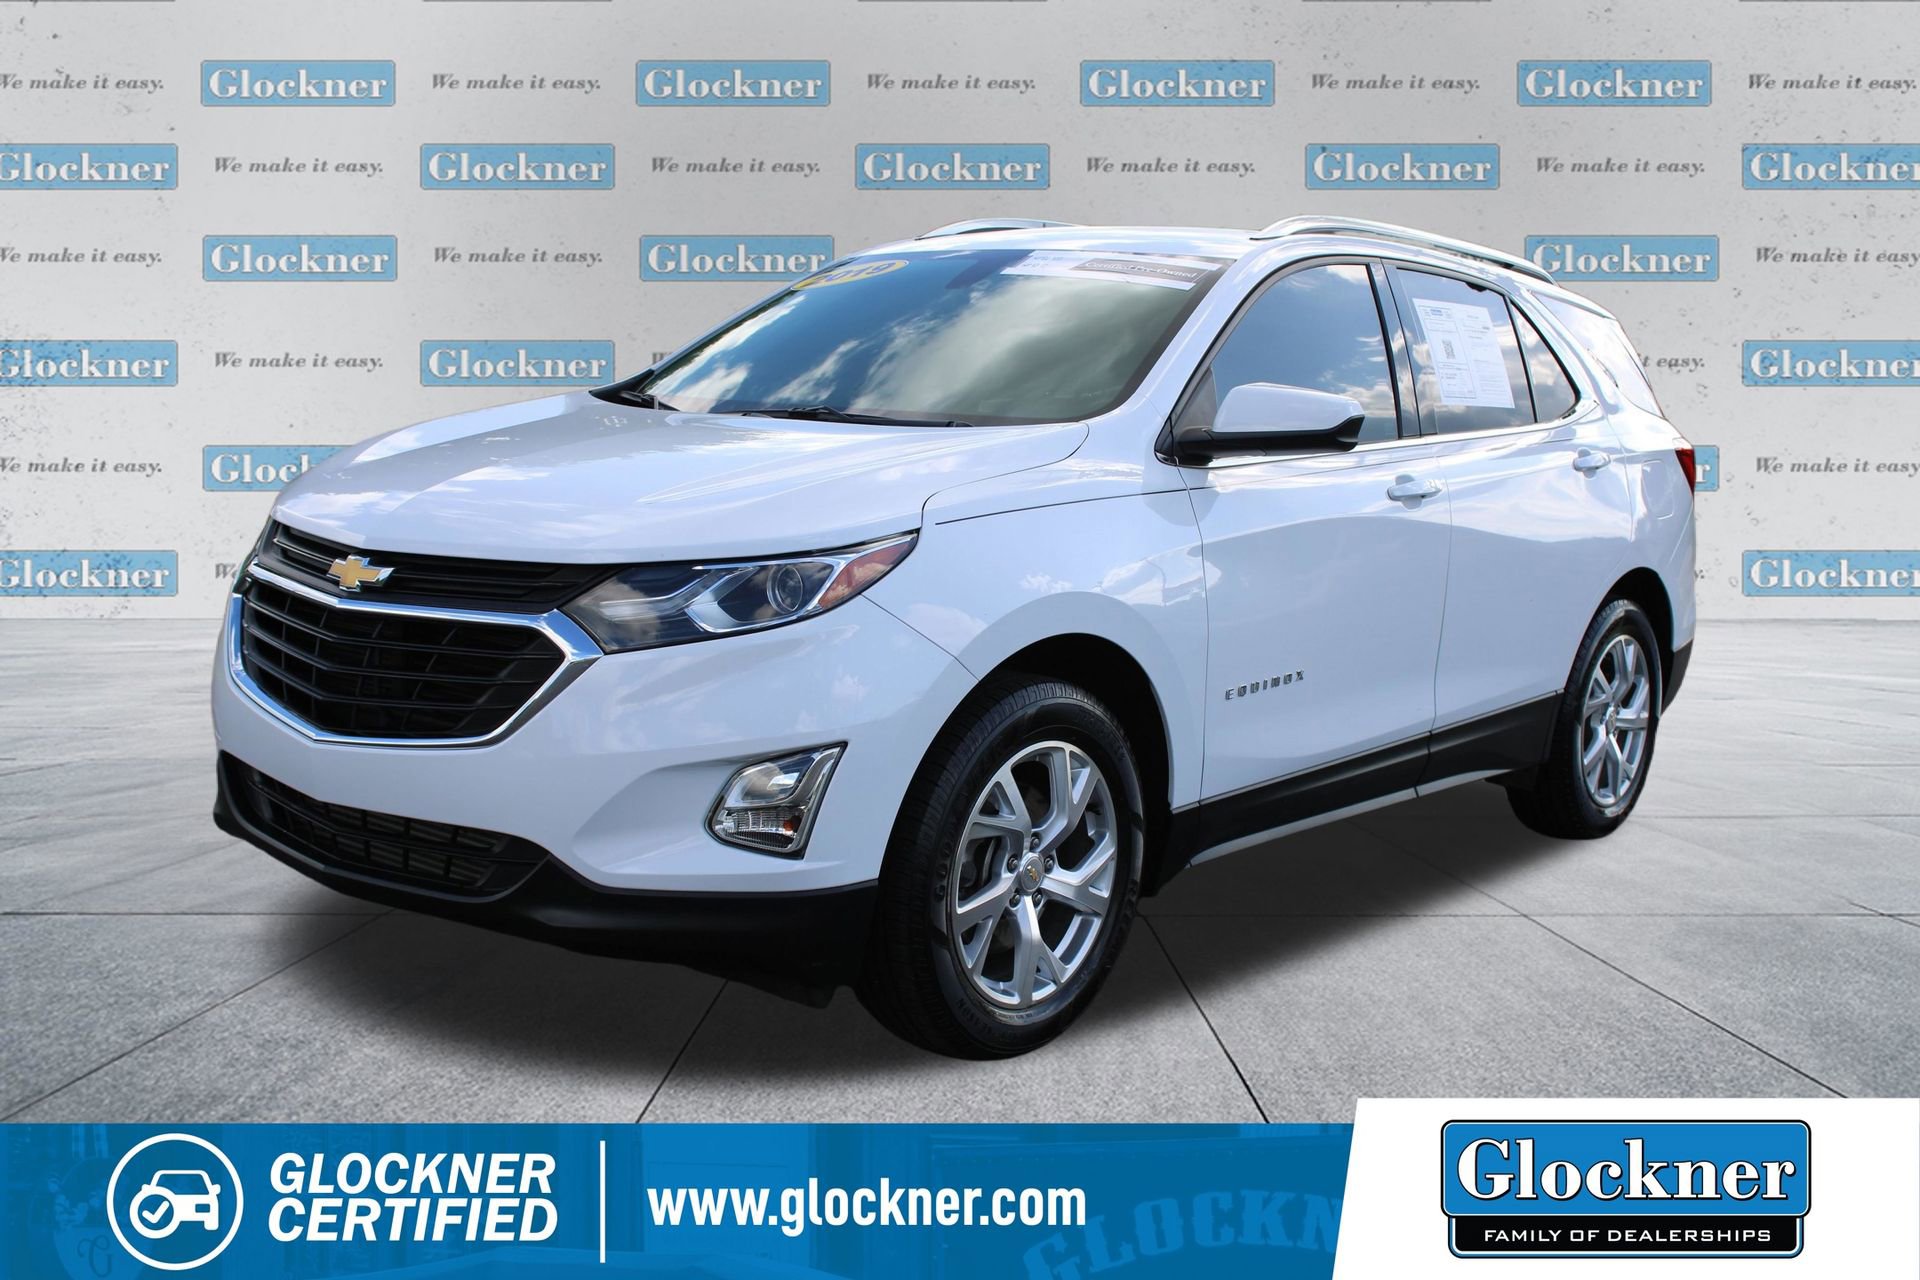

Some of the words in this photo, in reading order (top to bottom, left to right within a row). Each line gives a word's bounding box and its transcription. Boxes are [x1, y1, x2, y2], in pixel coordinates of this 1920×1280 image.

[30, 73, 88, 90] make
[94, 74, 110, 90] it
[116, 79, 165, 95] easy.
[209, 69, 388, 99] Glockner
[431, 73, 460, 90] We
[466, 73, 524, 90] make
[530, 74, 546, 90] it
[552, 79, 601, 95] easy.
[644, 69, 823, 99] Glockner
[866, 73, 895, 90] We
[901, 73, 959, 90] make
[965, 74, 981, 90] it
[987, 79, 1036, 95] easy.
[1088, 69, 1267, 99] Glockner
[1311, 73, 1340, 90] We
[1346, 73, 1404, 90] make
[1410, 74, 1426, 90] it
[1432, 79, 1481, 95] easy.
[1525, 69, 1704, 99] Glockner
[1748, 73, 1777, 90] We
[1783, 73, 1841, 90] make
[1847, 74, 1863, 90] it
[1869, 79, 1918, 95] easy.
[214, 156, 243, 173] We
[249, 156, 307, 173] make
[313, 157, 329, 173] it
[335, 162, 384, 178] easy.
[428, 152, 607, 182] Glockner
[651, 156, 680, 173] We
[686, 156, 744, 173] make
[750, 157, 766, 173] it
[772, 162, 821, 178] easy.
[863, 152, 1042, 182] Glockner
[1086, 156, 1115, 173] We
[1121, 156, 1179, 173] make
[1185, 157, 1201, 173] it
[1207, 162, 1256, 178] easy.
[1313, 152, 1492, 182] Glockner
[1536, 156, 1565, 173] We
[1571, 156, 1629, 173] make
[1635, 157, 1651, 173] it
[1657, 162, 1706, 178] easy.
[28, 246, 86, 263] make
[92, 247, 108, 263] it
[114, 252, 163, 268] easy.
[211, 244, 390, 274] Glockner
[433, 246, 462, 263] We
[468, 246, 526, 263] make
[532, 247, 548, 263] it
[554, 252, 603, 268] easy.
[647, 244, 826, 274] Glockner
[1532, 244, 1711, 274] Glockner
[1755, 246, 1784, 263] We
[1790, 246, 1848, 263] make
[1854, 247, 1870, 263] it
[214, 351, 243, 368] We
[249, 351, 307, 368] make
[313, 352, 329, 368] it
[335, 357, 384, 373] easy.
[428, 349, 607, 379] Glockner
[1656, 357, 1705, 373] easy.
[28, 456, 86, 473] make
[92, 457, 108, 473] it
[114, 462, 163, 478] easy.
[210, 453, 310, 484] Gloc
[1755, 456, 1784, 473] We
[1790, 456, 1848, 473] make
[1854, 457, 1870, 473] it
[215, 562, 237, 579] W
[1225, 669, 1305, 701] EQUINOX
